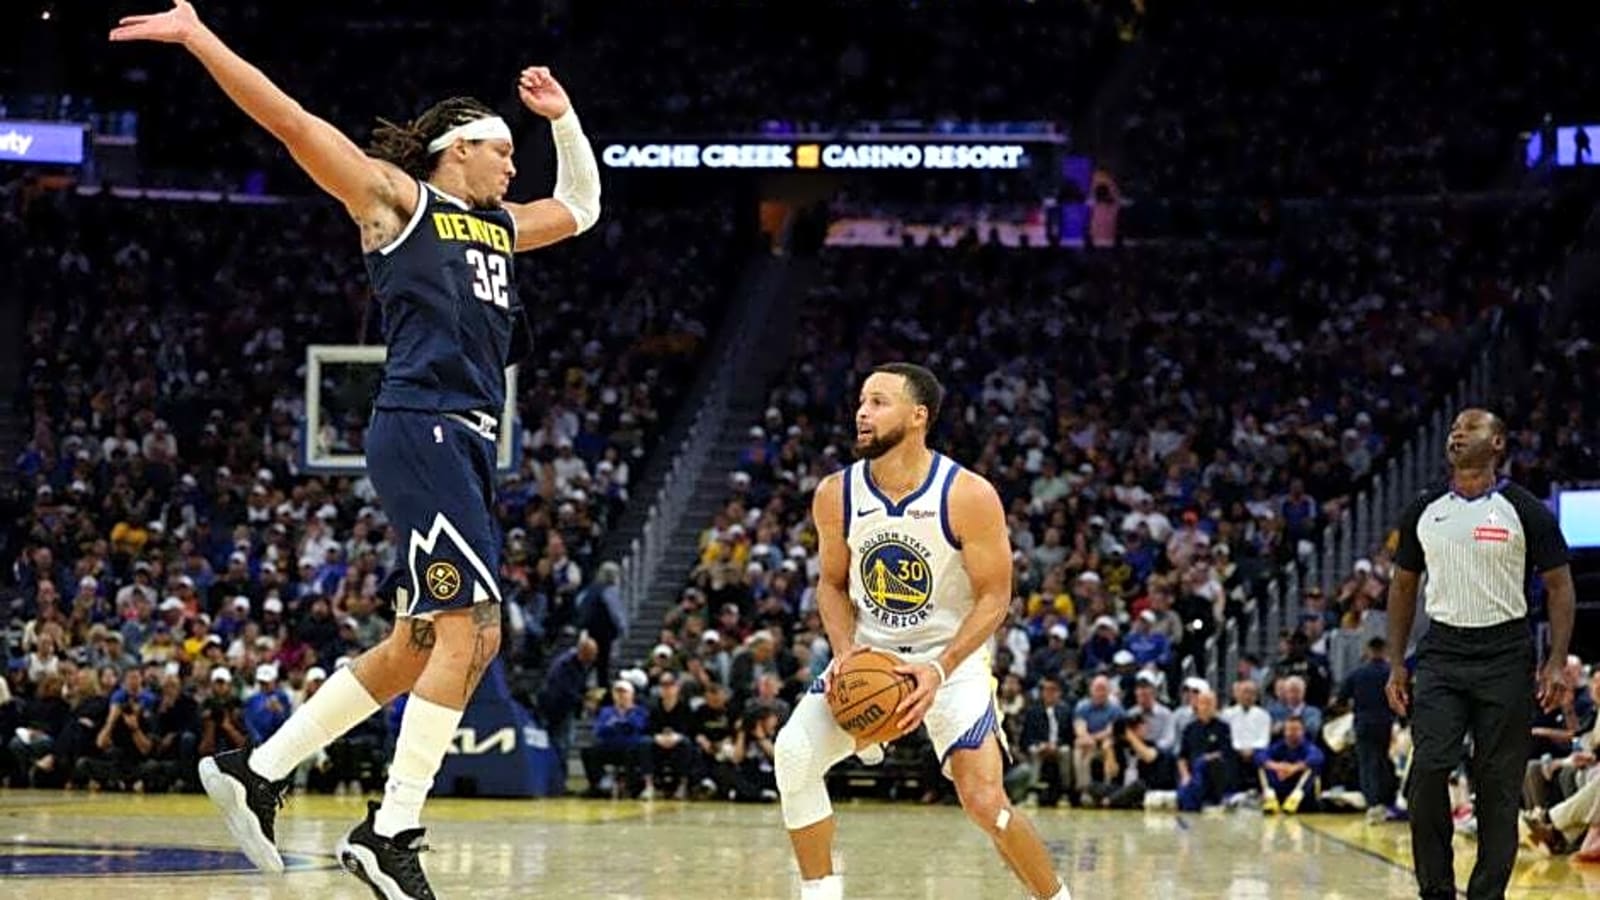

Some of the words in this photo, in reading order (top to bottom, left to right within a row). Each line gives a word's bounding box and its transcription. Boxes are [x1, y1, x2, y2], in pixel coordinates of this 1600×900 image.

[603, 144, 699, 167] CACHE
[701, 144, 793, 167] CREEK
[822, 144, 921, 168] CASINO
[924, 144, 1023, 168] RESORT
[465, 248, 509, 309] 32
[859, 531, 899, 554] GOLDEN
[903, 535, 931, 558] STATE
[898, 559, 923, 581] 30
[863, 595, 934, 627] WARRIORS
